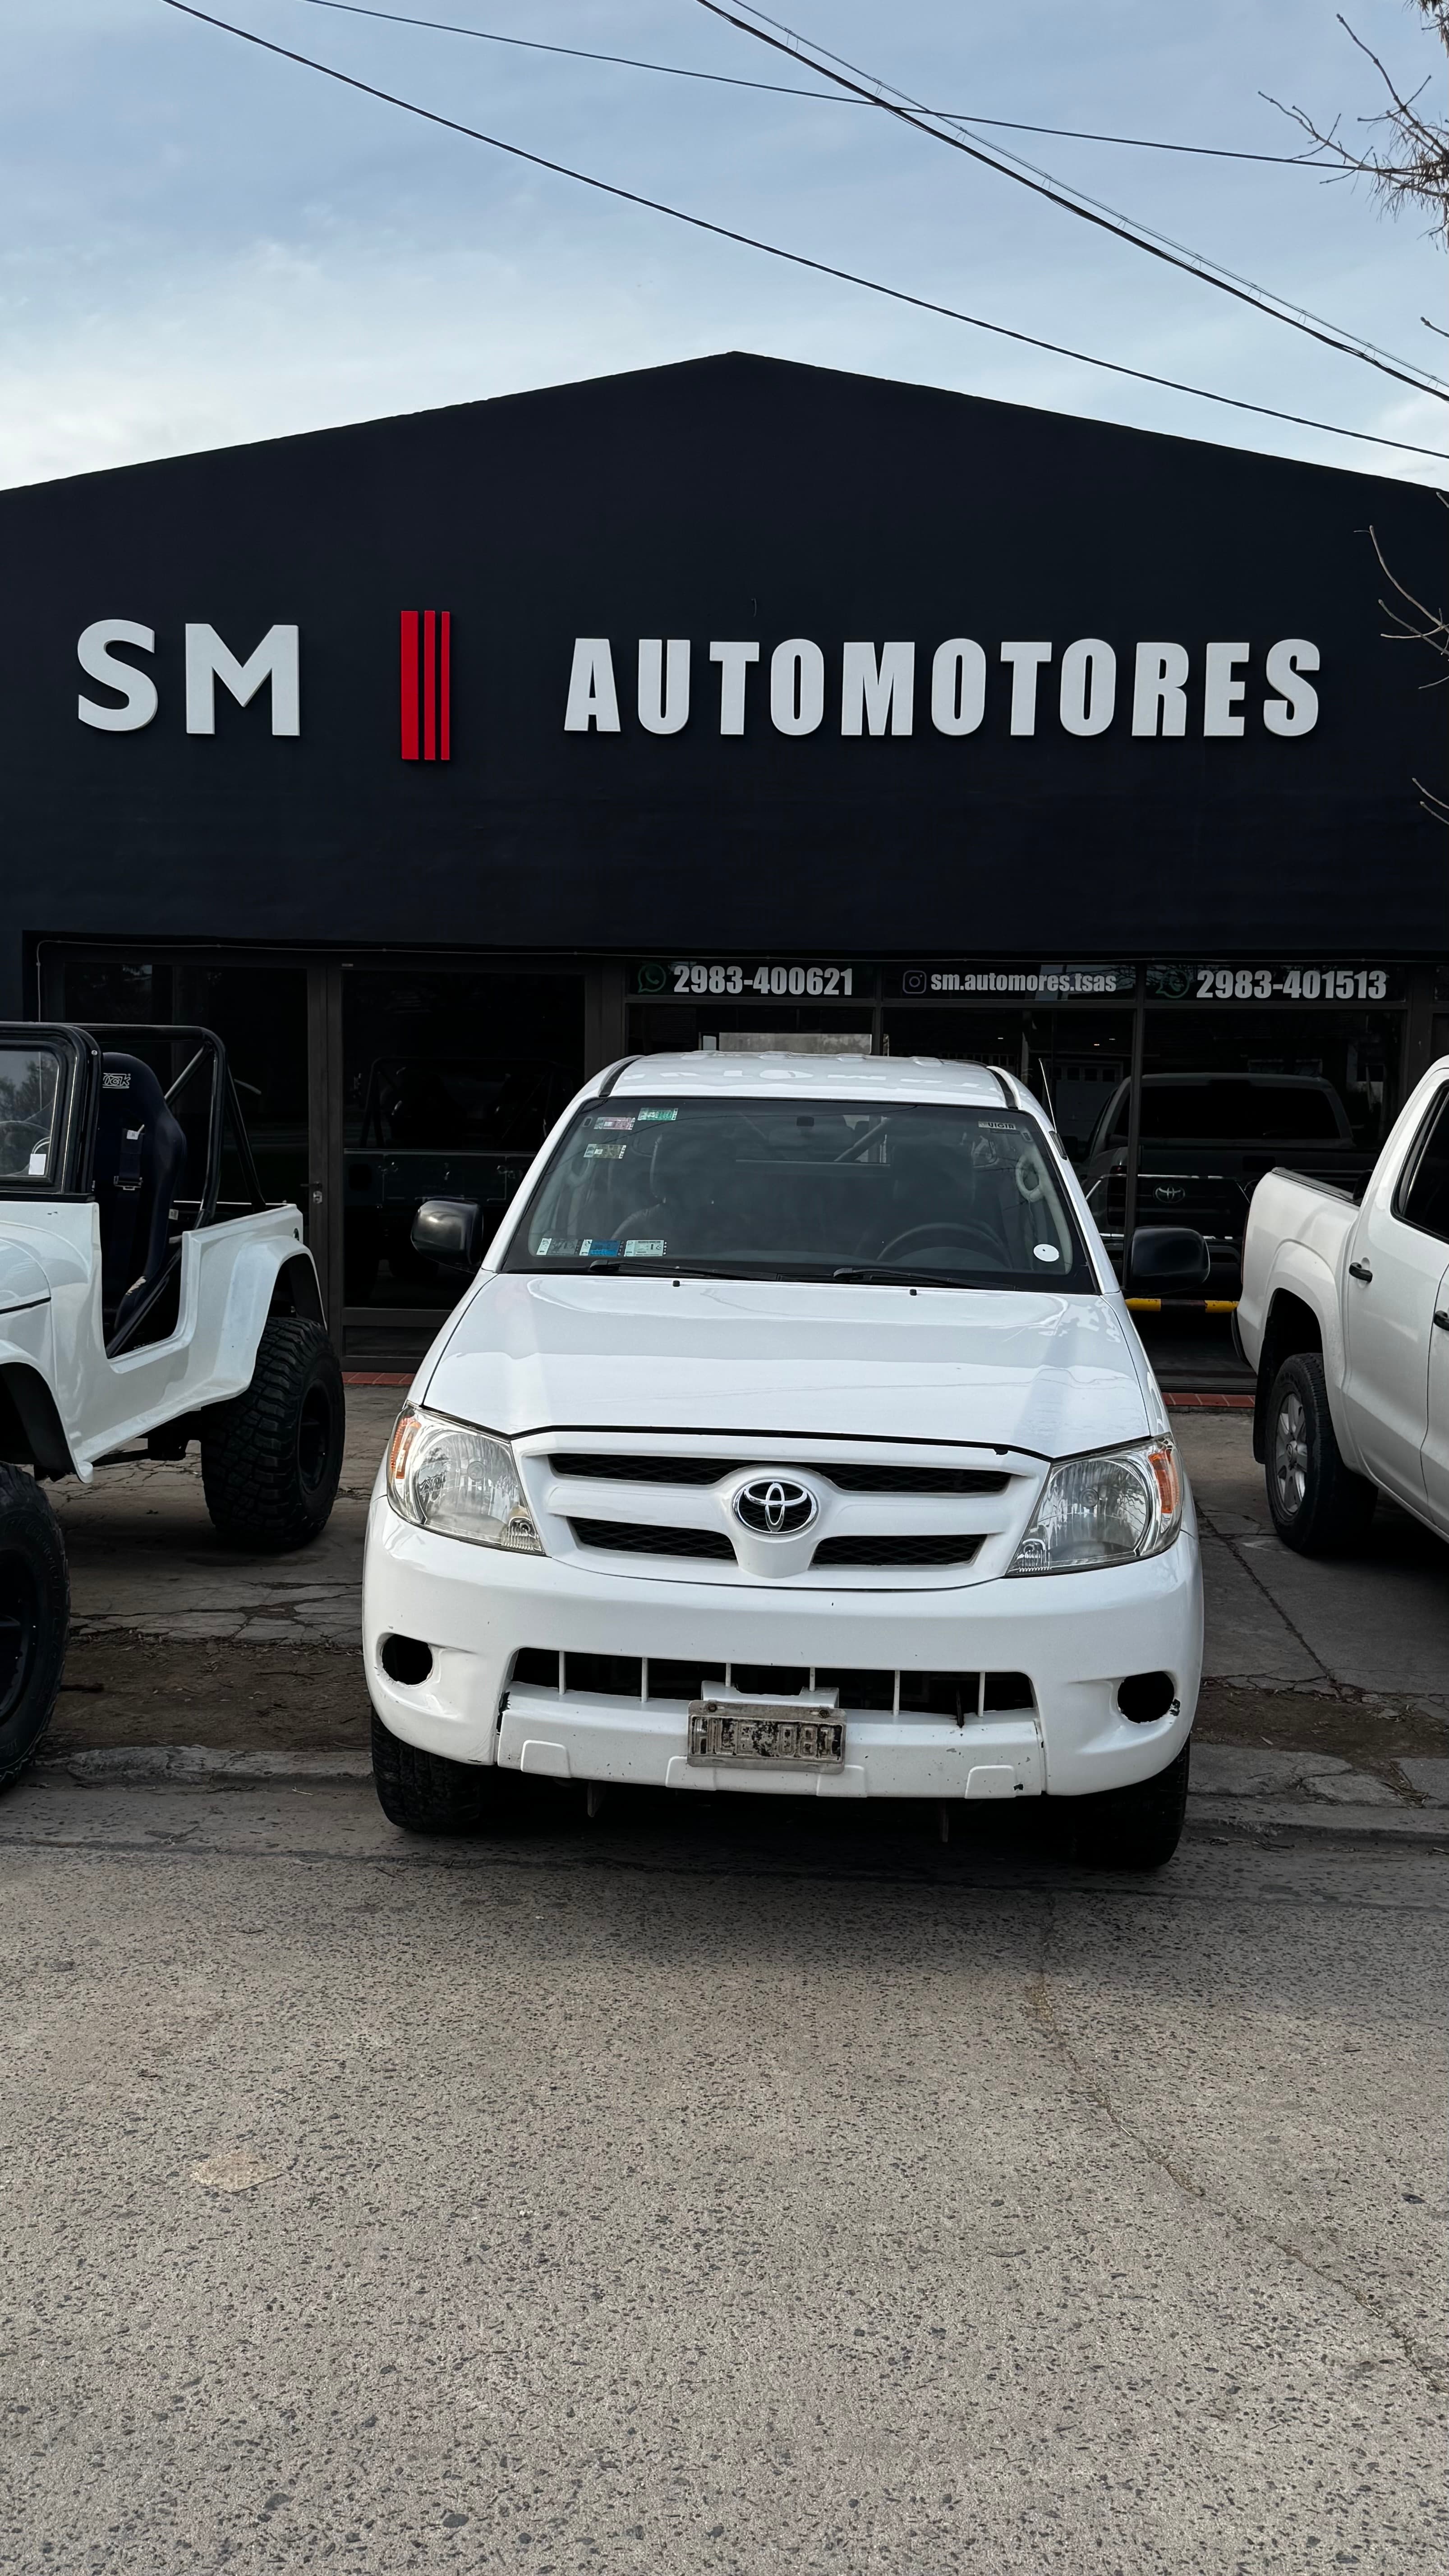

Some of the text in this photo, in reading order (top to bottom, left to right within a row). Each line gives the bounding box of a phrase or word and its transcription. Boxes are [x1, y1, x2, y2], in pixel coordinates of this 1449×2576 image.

[77, 619, 1320, 737] SM AUTOMOTORES
[674, 965, 852, 995] 2983-400621
[931, 973, 1116, 992] sm.automores.tsas
[1196, 971, 1386, 999] 2983-401513
